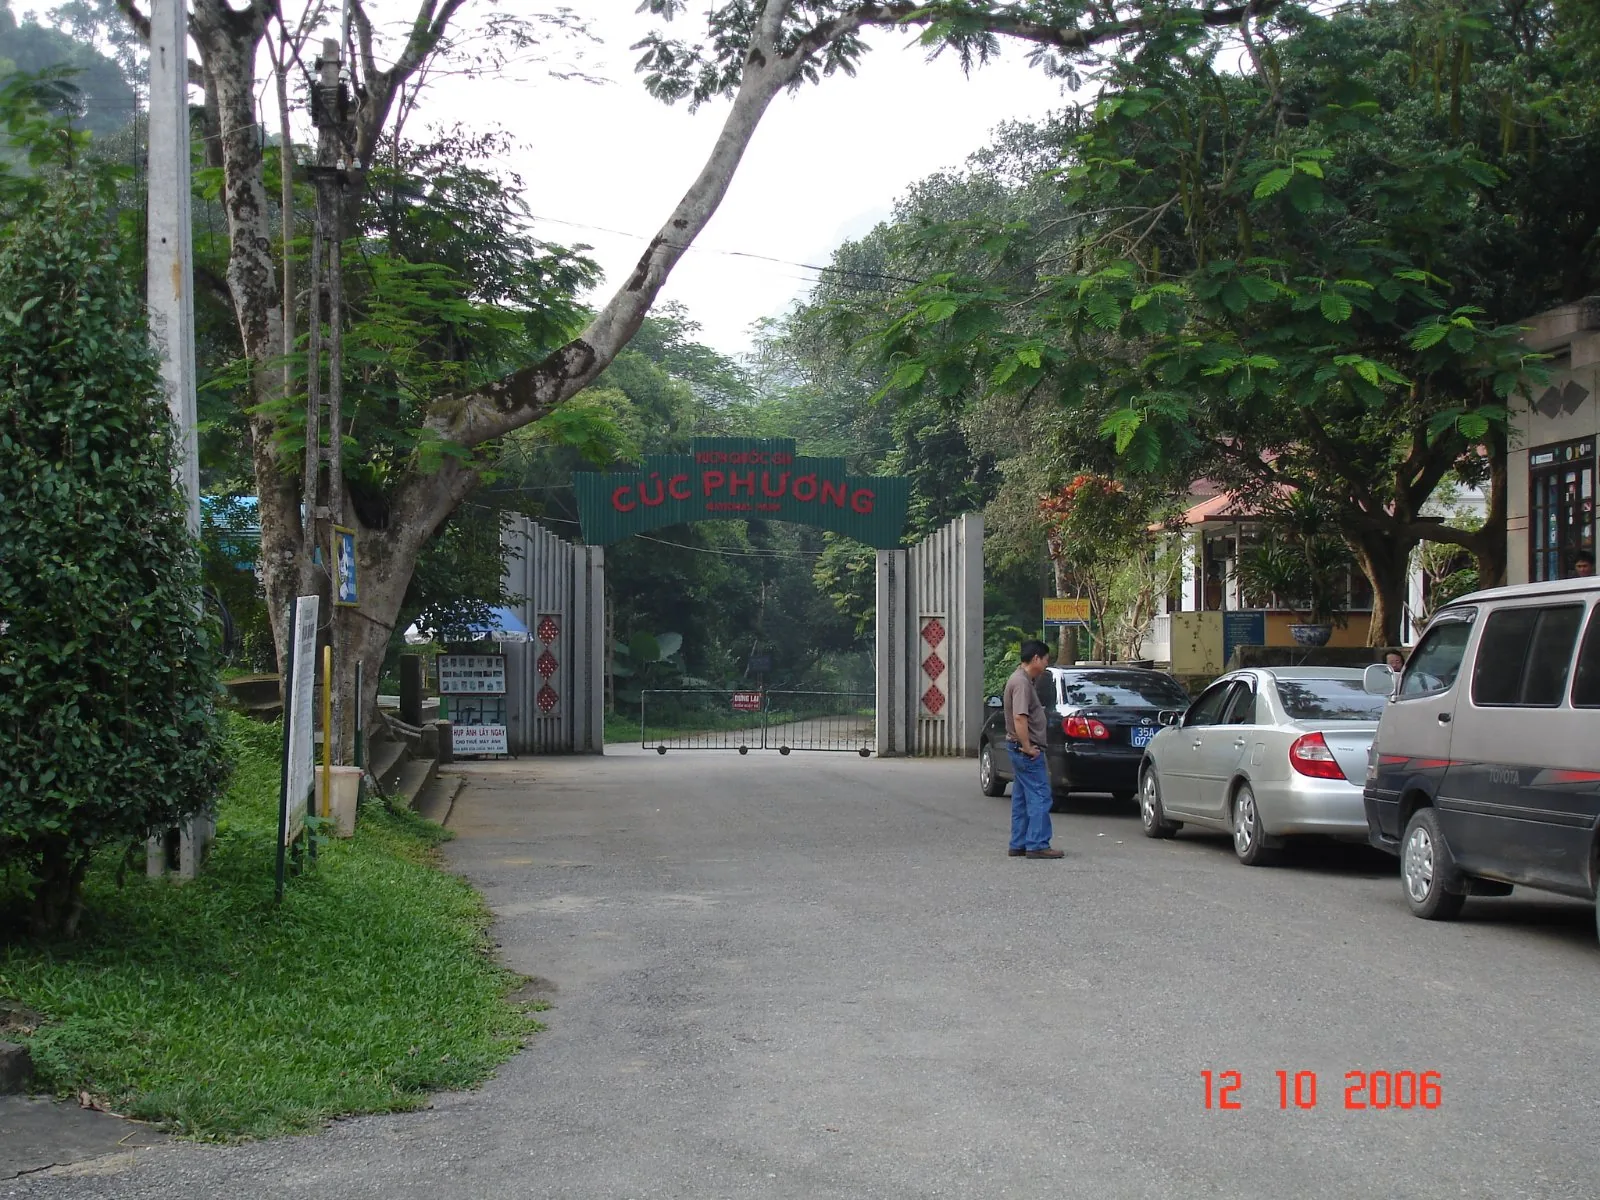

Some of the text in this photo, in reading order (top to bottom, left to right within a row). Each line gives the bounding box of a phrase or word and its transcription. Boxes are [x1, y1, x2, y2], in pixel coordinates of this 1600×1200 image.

[611, 470, 876, 514] CÚC PHƯƠNG
[1137, 727, 1155, 737] 35A
[1489, 768, 1520, 785] TOYOTA
